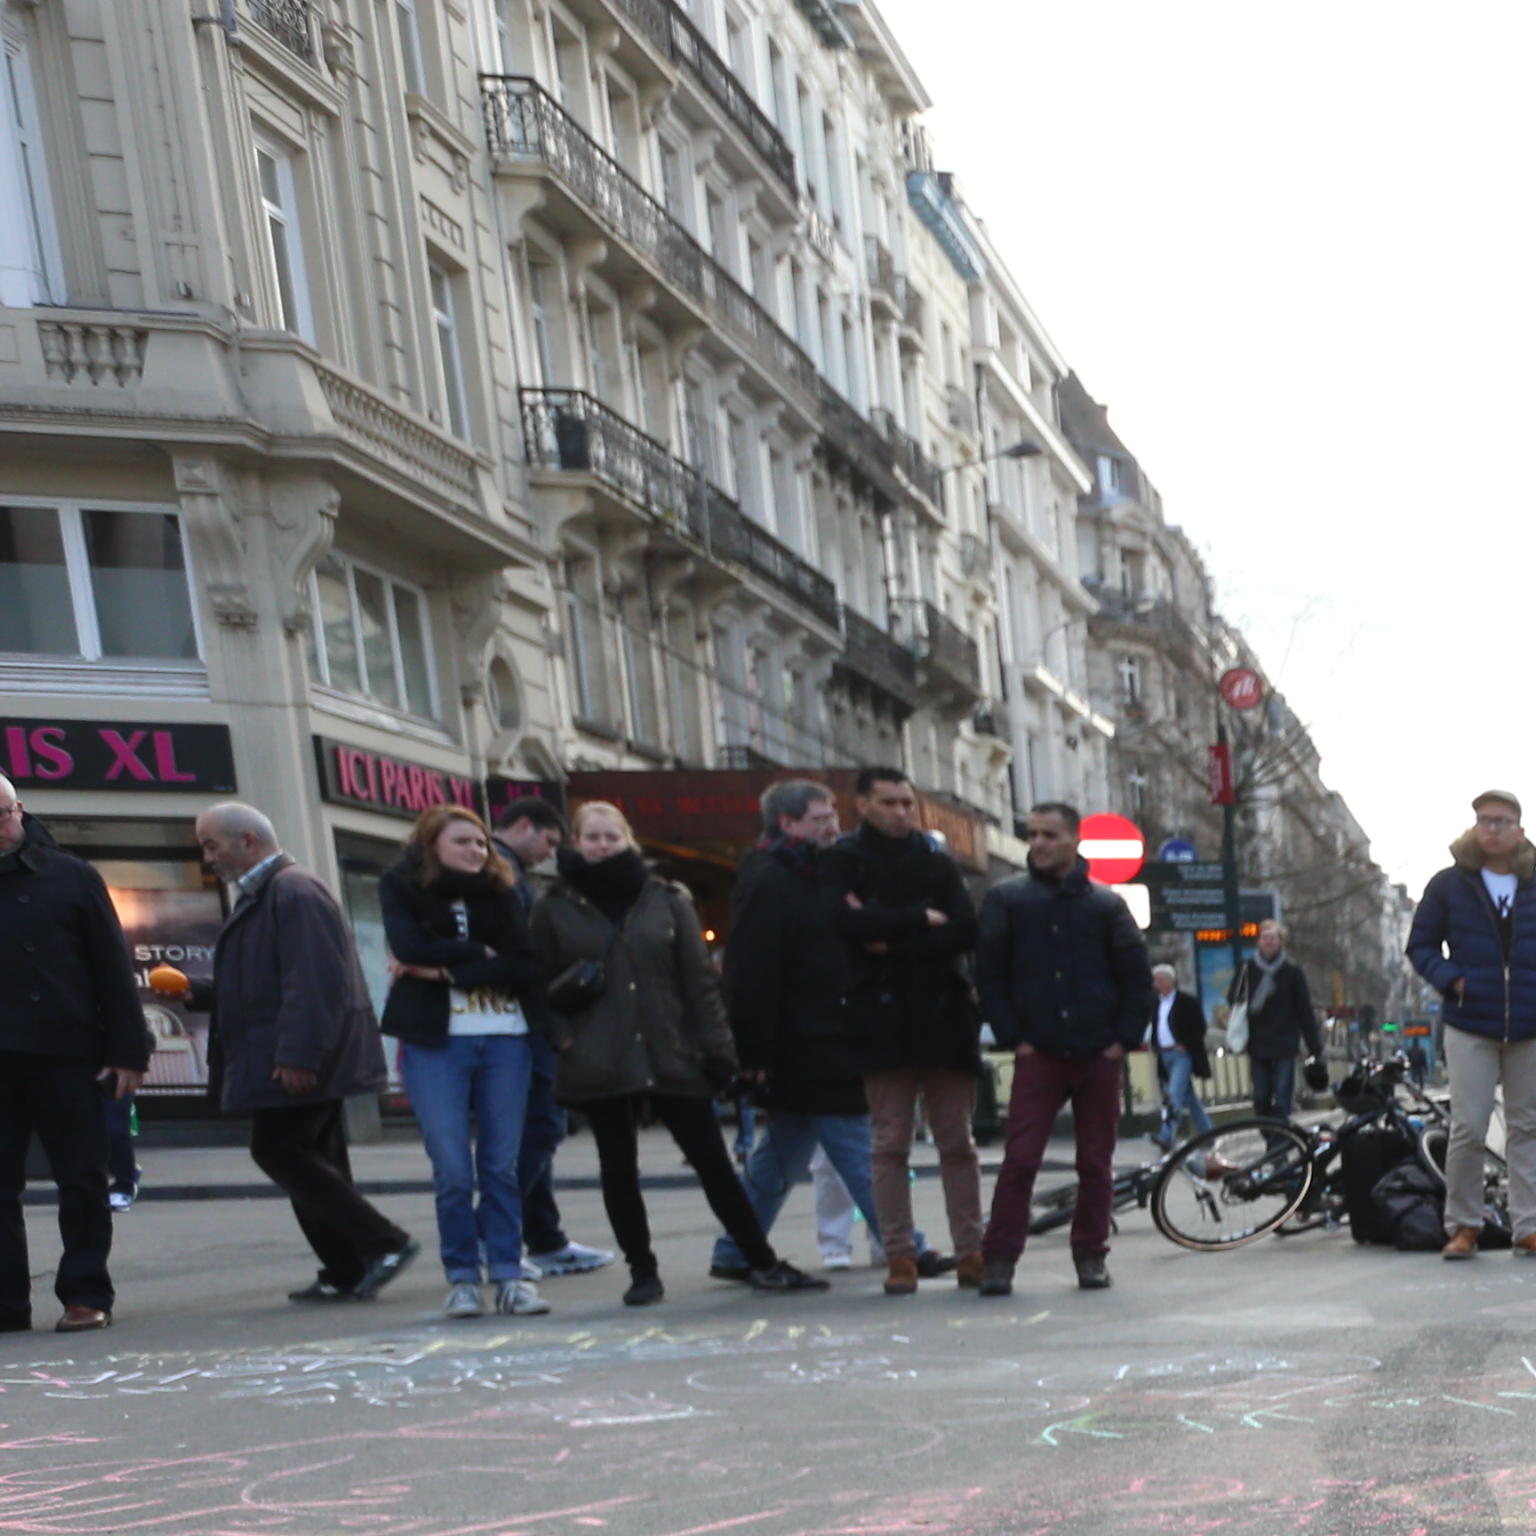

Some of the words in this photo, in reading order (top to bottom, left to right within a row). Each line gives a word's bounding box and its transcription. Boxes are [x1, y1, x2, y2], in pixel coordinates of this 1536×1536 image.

[0, 725, 76, 780] IS
[99, 727, 197, 783] XL
[337, 745, 377, 801] ICI
[380, 755, 446, 812] PARIS
[134, 944, 214, 963] STORY
